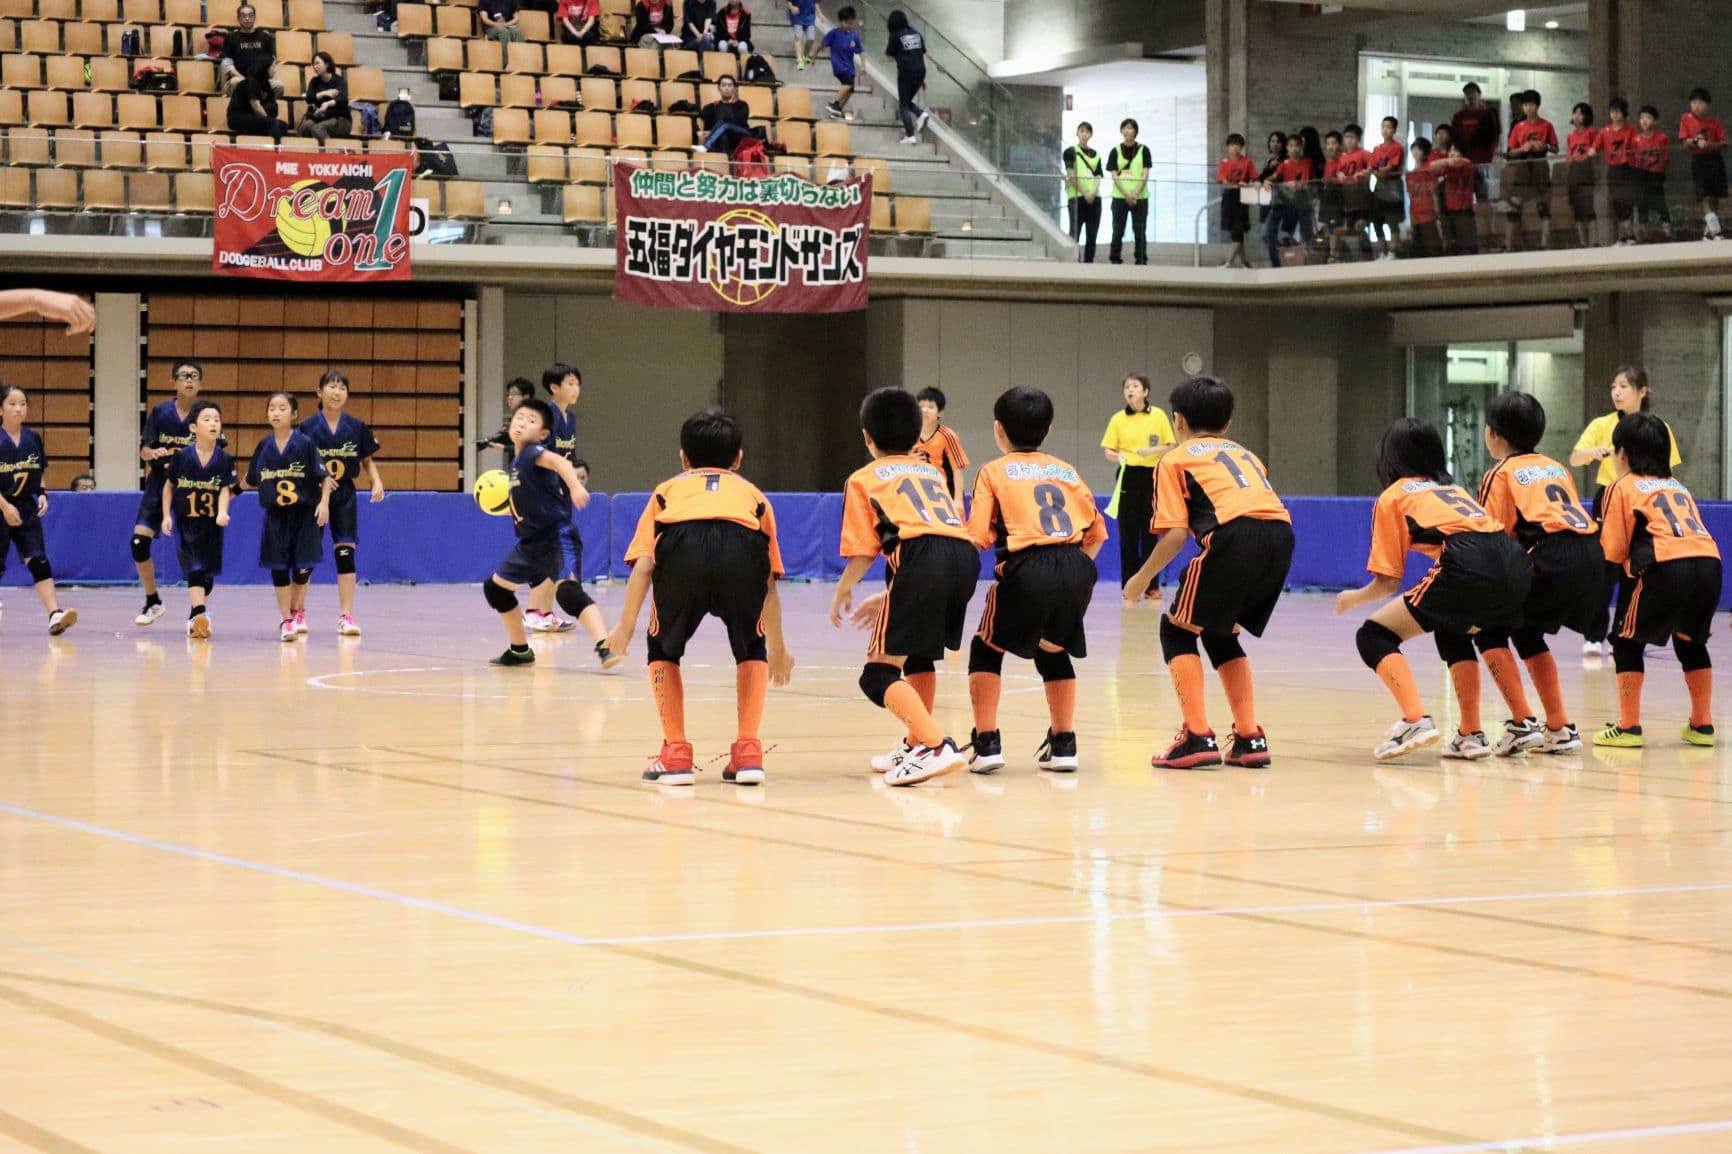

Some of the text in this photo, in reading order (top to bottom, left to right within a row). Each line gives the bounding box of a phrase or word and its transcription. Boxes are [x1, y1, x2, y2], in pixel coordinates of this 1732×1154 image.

[275, 161, 374, 178] MIE YOKKAICHI
[218, 162, 376, 222] Dream
[631, 170, 861, 208] 仲間と努力は裏切らない
[218, 250, 324, 272] DODGEBALL CLUB
[323, 232, 407, 266] one
[625, 216, 866, 286] 五福ダイヤモンドサンズ
[11, 471, 29, 497] 7
[325, 459, 346, 482] 9
[1213, 450, 1273, 491] 11
[186, 491, 216, 519] 13
[276, 480, 299, 507] 8
[896, 478, 963, 527] 15
[1033, 483, 1074, 538] 8
[1432, 488, 1487, 518] 5
[1545, 483, 1589, 530] 3
